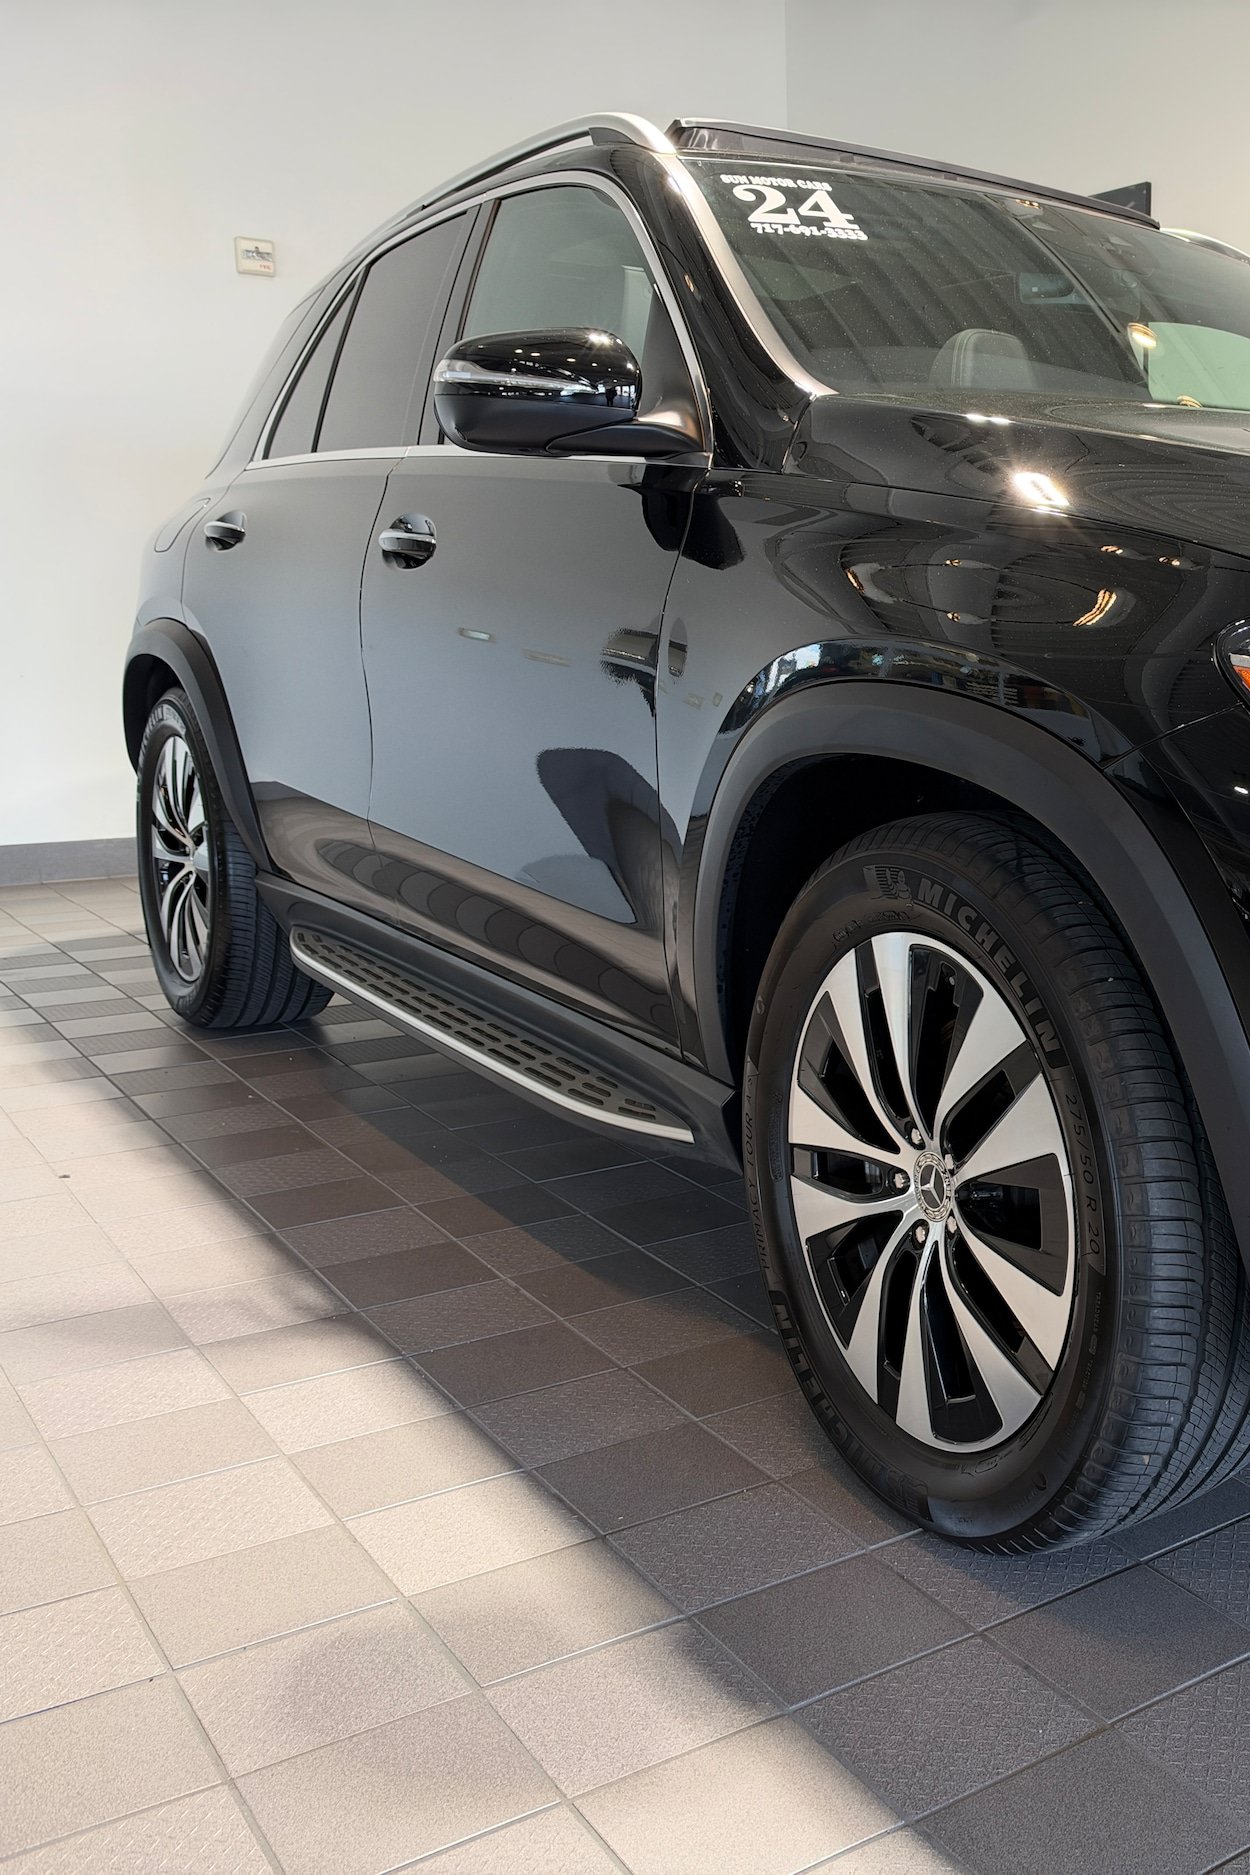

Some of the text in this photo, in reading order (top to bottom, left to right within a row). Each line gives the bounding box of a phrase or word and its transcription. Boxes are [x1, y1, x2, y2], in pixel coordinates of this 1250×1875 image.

[720, 174, 832, 192] SUN MOTOR CARS
[732, 184, 861, 230] 24
[916, 877, 1062, 1053] MICHELIN
[744, 1111, 756, 1168] TOUR
[1065, 1093, 1101, 1255] 275/50 R 20
[747, 1177, 771, 1270] PRIMACY
